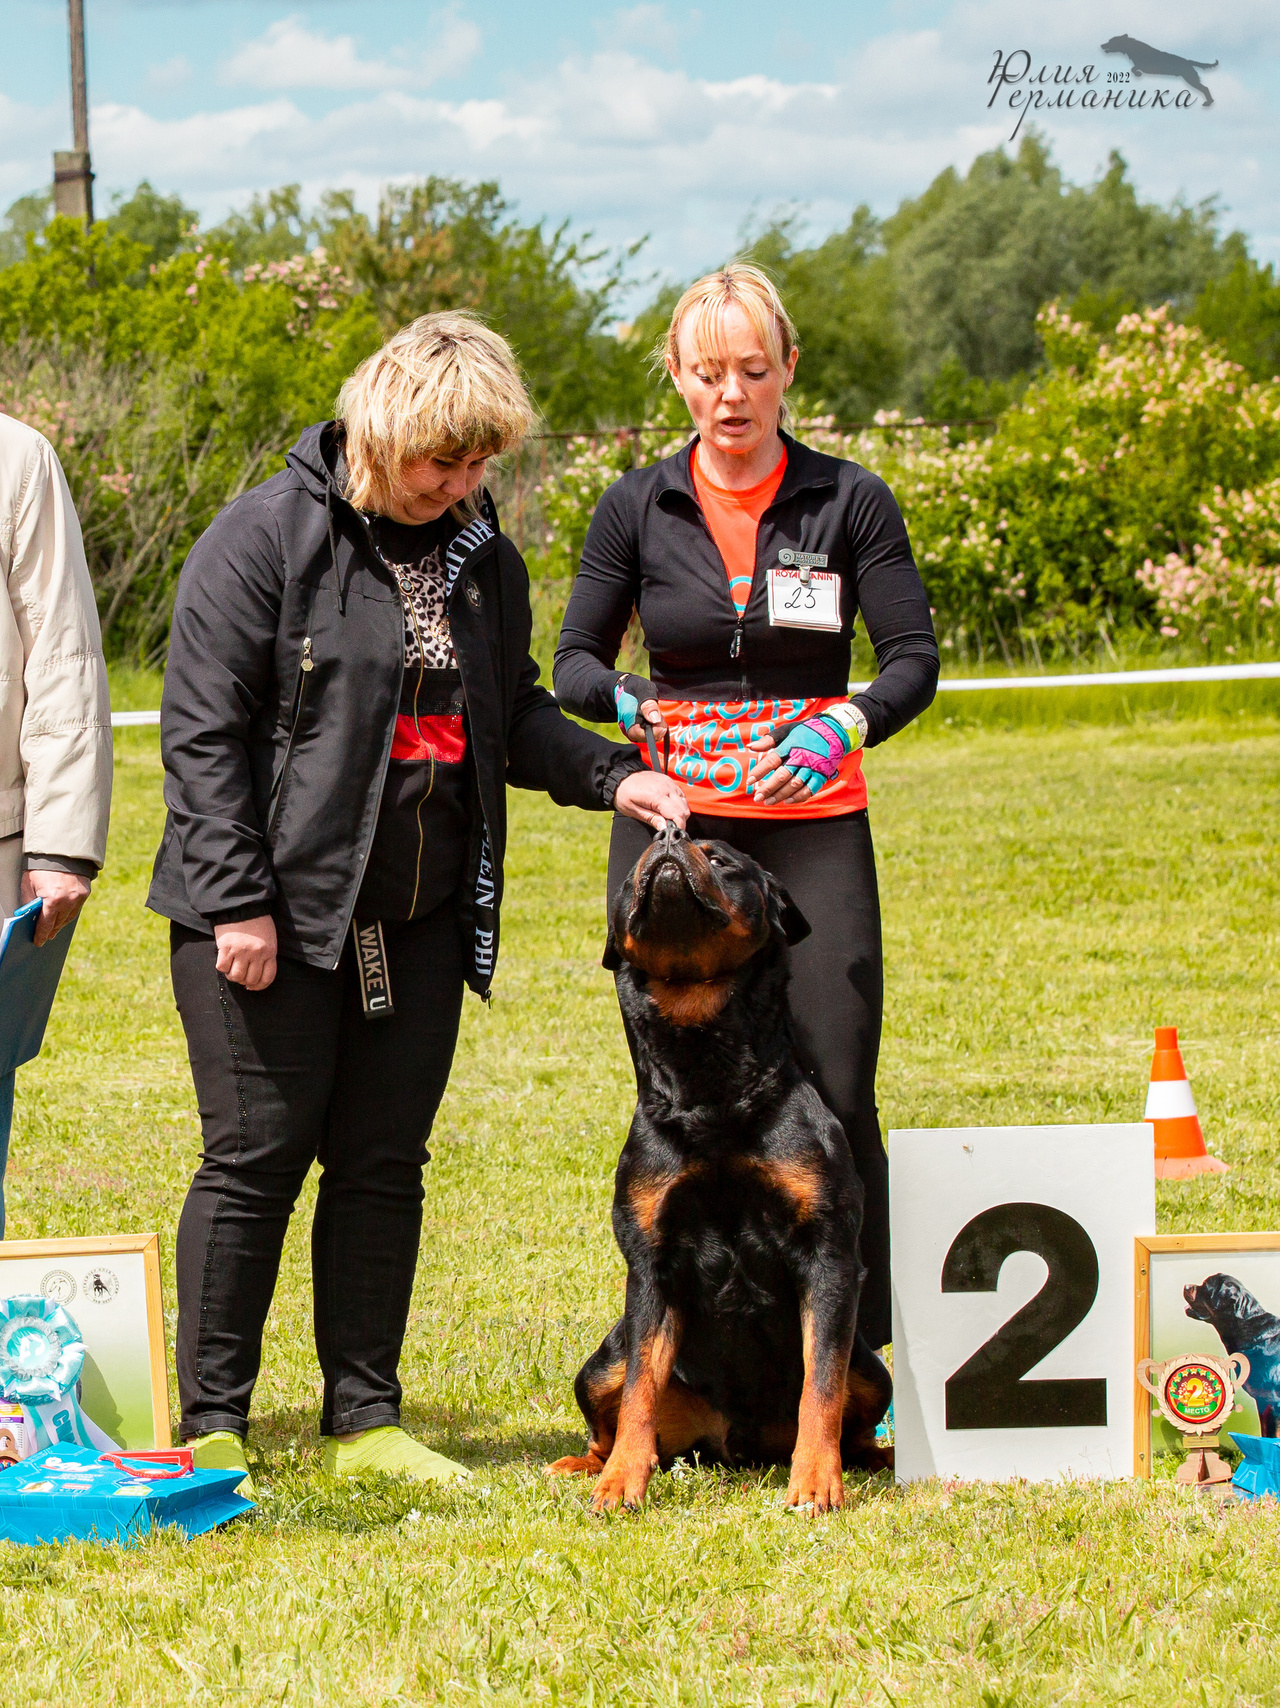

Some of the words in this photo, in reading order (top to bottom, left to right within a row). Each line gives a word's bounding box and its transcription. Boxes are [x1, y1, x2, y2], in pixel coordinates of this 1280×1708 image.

[811, 571, 833, 581] ANIN
[784, 587, 821, 609] 25
[360, 925, 384, 992] WAKE
[369, 996, 387, 1011] U
[941, 1202, 1108, 1430] 2
[1187, 1378, 1204, 1406] 2
[1184, 1406, 1210, 1414] МЕСТО
